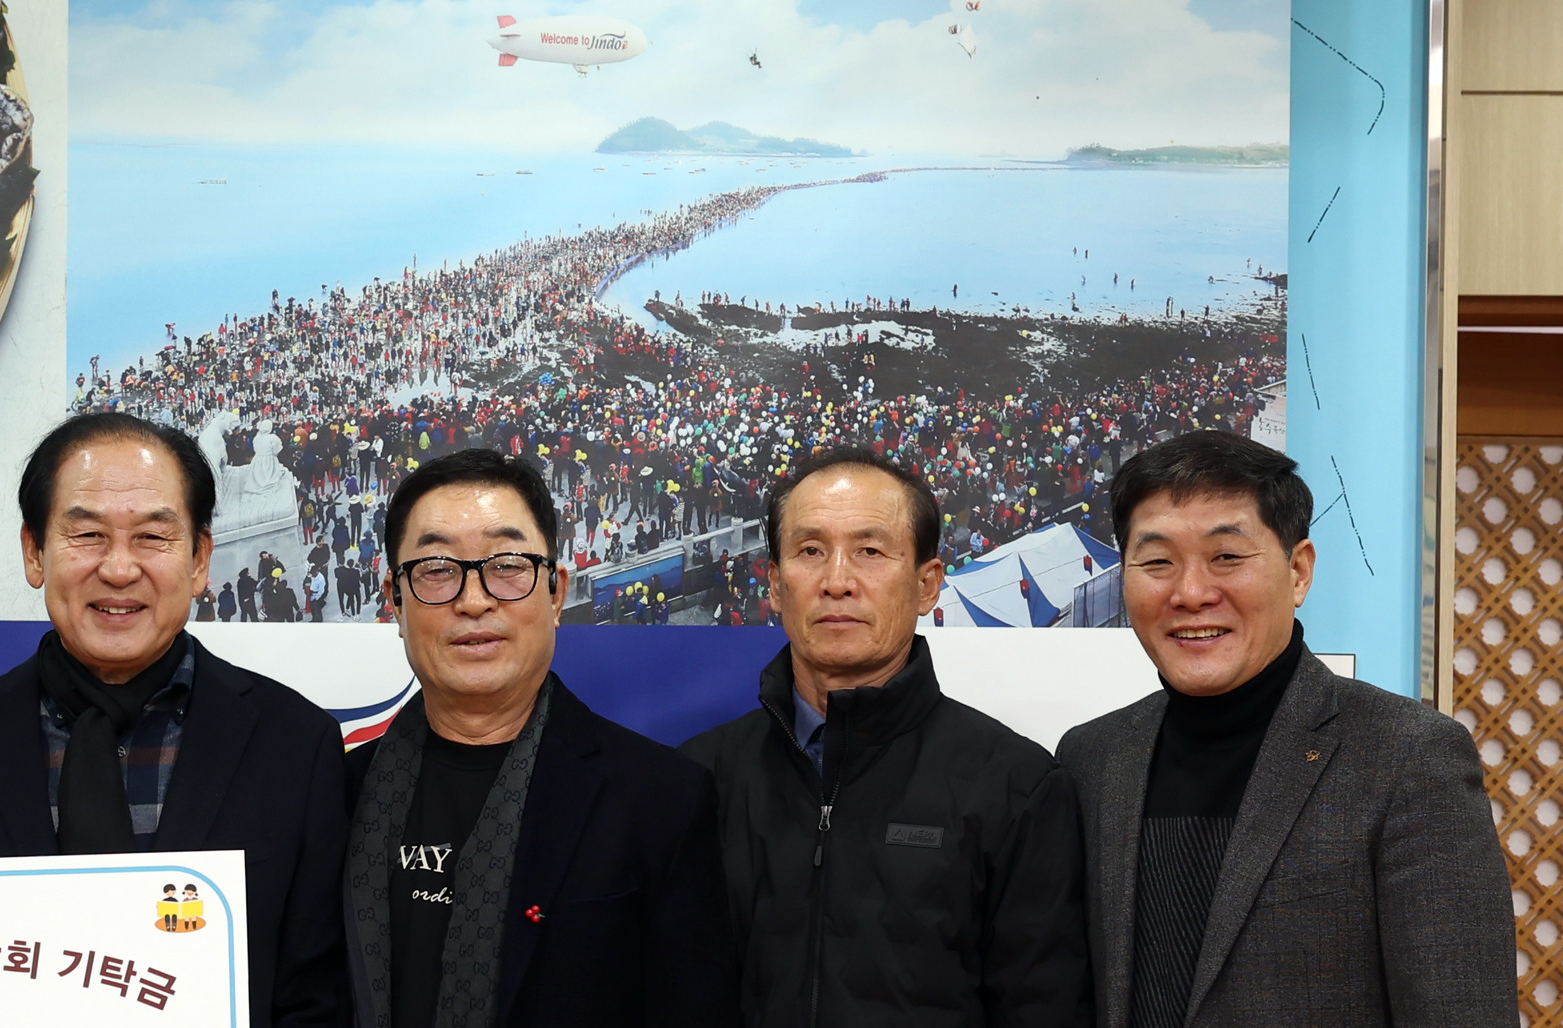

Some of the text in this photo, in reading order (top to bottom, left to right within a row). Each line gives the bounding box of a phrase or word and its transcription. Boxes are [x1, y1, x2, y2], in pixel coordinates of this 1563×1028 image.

[540, 32, 579, 46] Welcome
[581, 35, 590, 46] to
[57, 949, 178, 1011] 기탁금
